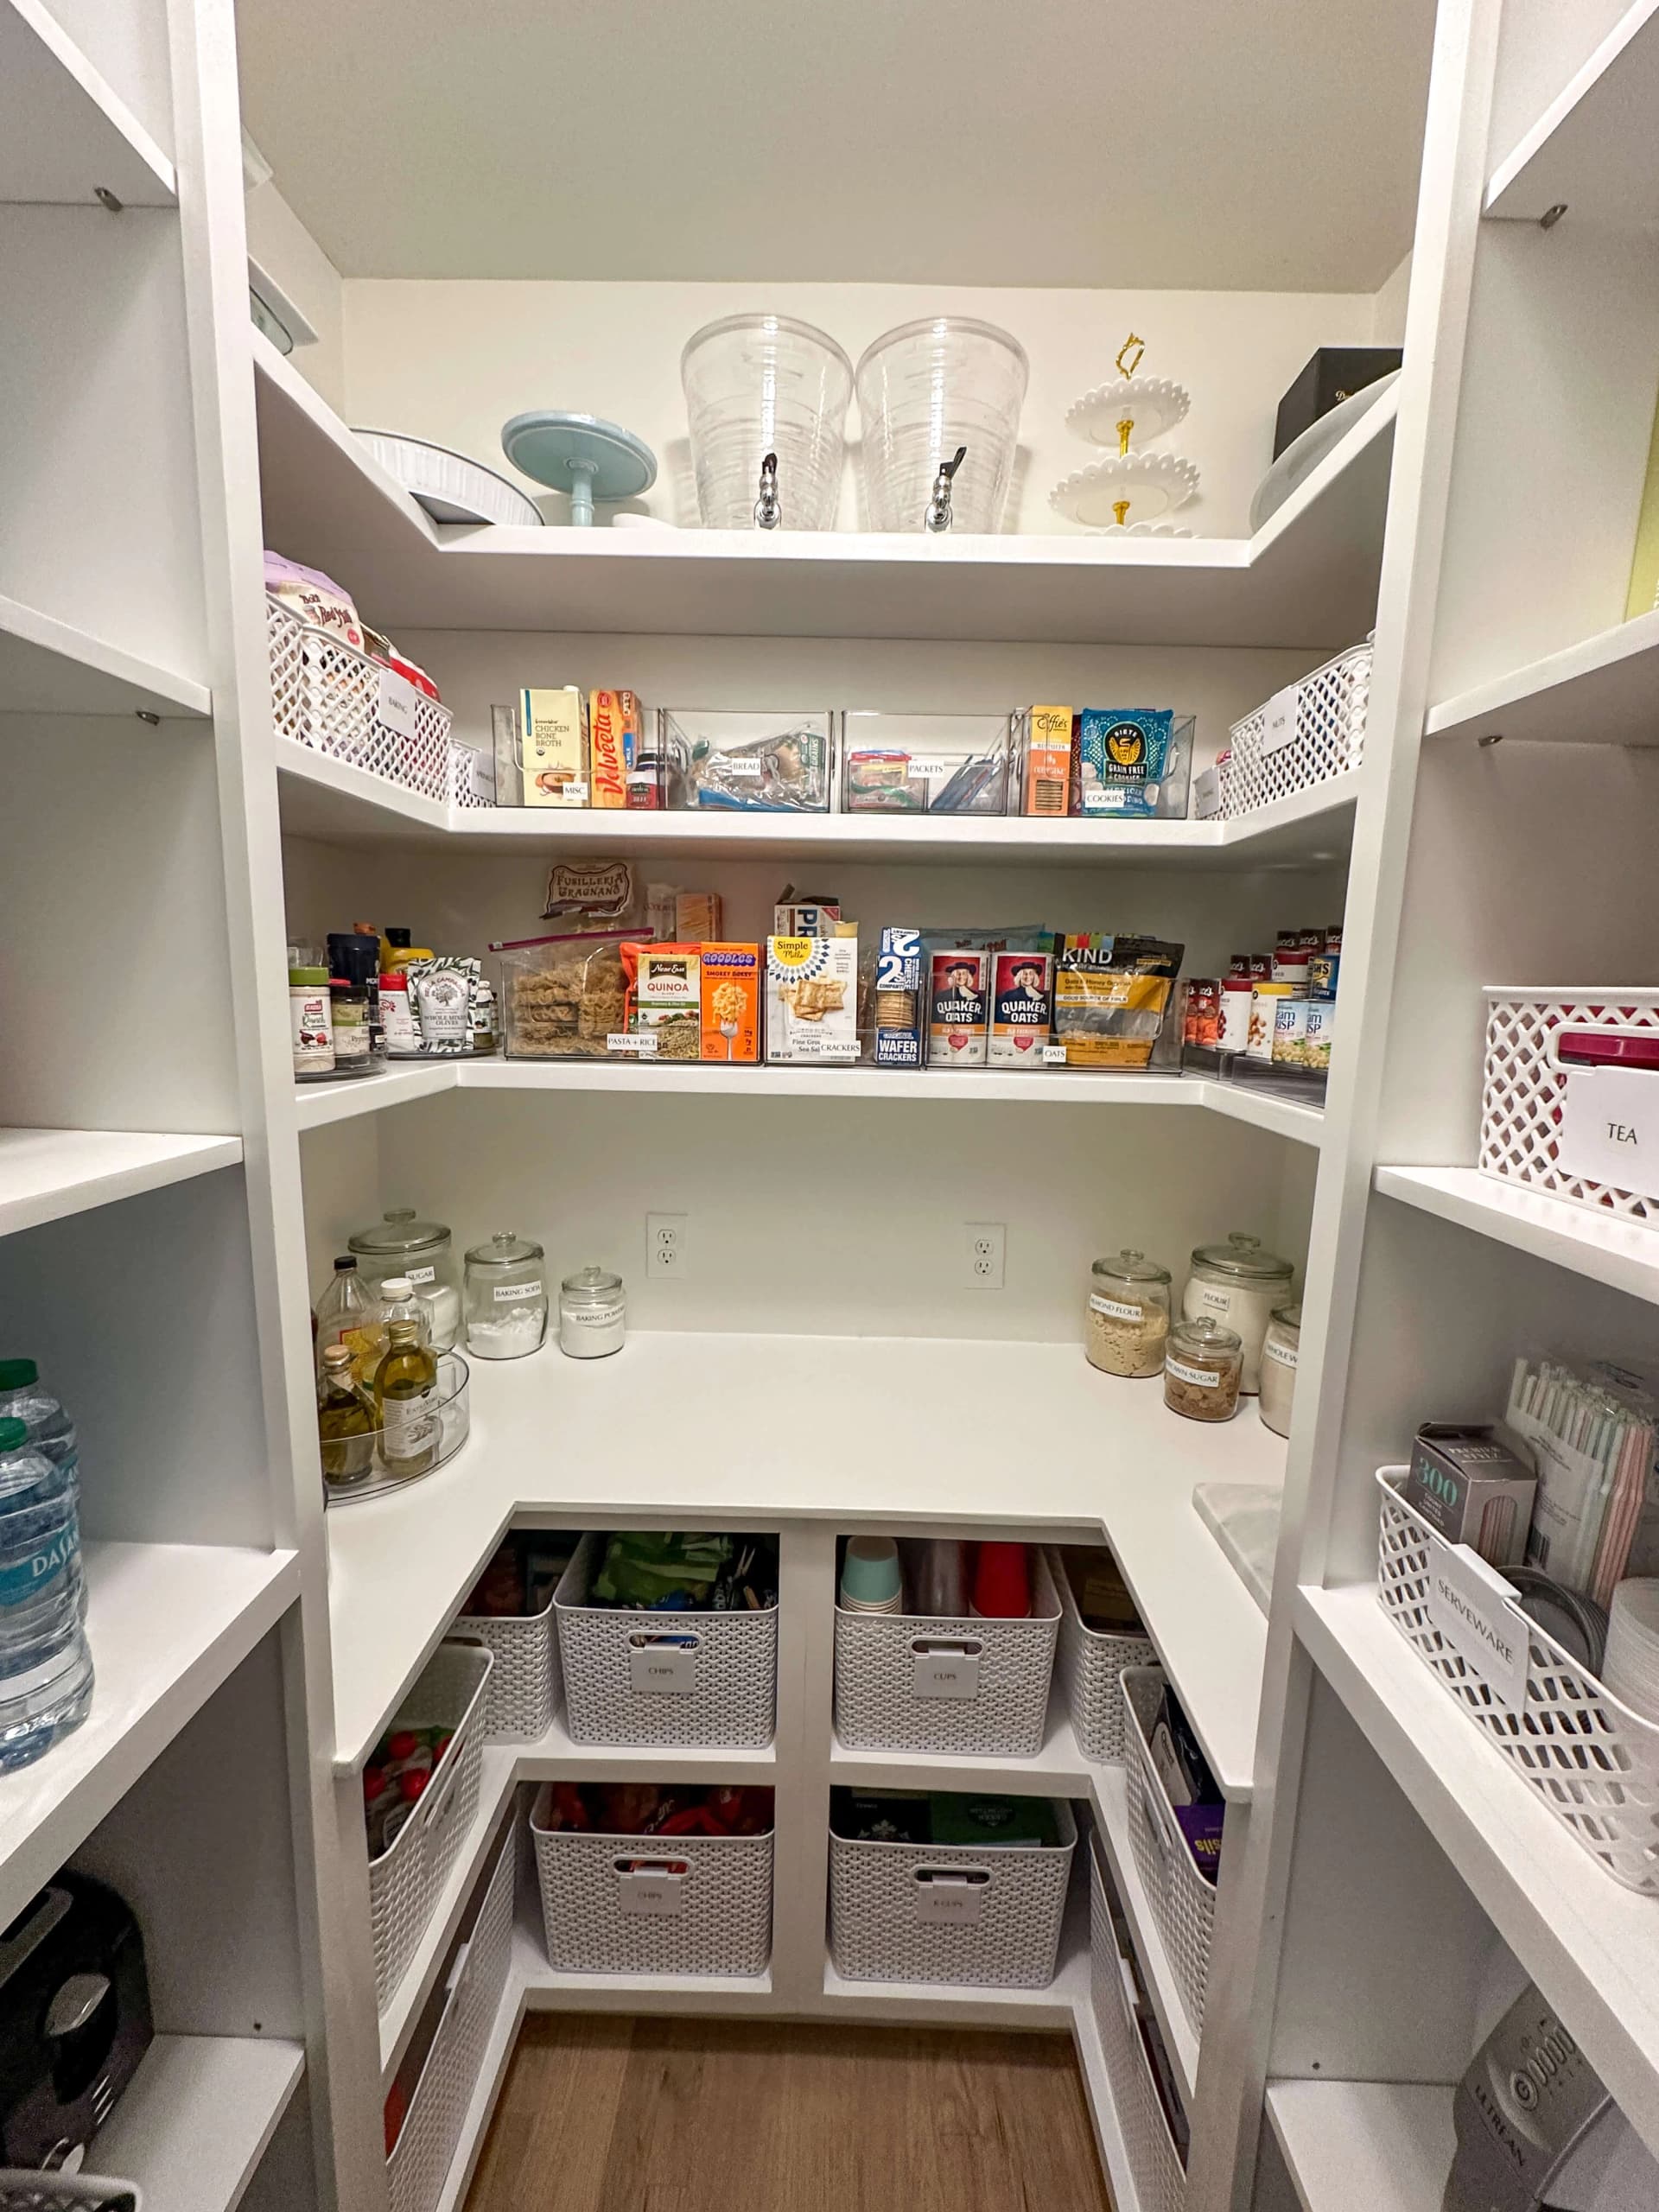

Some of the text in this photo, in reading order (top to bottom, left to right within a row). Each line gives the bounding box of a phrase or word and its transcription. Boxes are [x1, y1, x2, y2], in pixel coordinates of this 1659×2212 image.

[593, 715, 624, 794] Velveeta
[909, 764, 944, 773] PACKETS
[1128, 765, 1145, 775] FREE
[1086, 794, 1123, 803] COOKIES
[778, 941, 809, 950] Simple
[1062, 948, 1113, 964] KIND
[646, 982, 690, 992] QUINOA
[937, 1000, 982, 1014] QUAKER
[1001, 1000, 1047, 1014] QUAKER
[945, 1012, 973, 1023] OATS
[1010, 1013, 1039, 1023] OATS
[879, 1039, 918, 1053] WAFER
[878, 1052, 917, 1062] CRACKERS
[1044, 1049, 1065, 1058] OATS
[1607, 1122, 1637, 1145] TEA
[495, 1285, 540, 1297] BAKING SODA
[1204, 1292, 1228, 1306] FLOUR
[575, 1313, 604, 1322] BAKING
[1115, 1306, 1141, 1318] FLOUR
[1188, 1371, 1218, 1383] SUGAR
[1415, 1456, 1459, 1507] 300
[1437, 1577, 1515, 1666] SERVEWARE
[647, 1666, 674, 1676] CHIPS
[933, 1672, 957, 1681] CUPS
